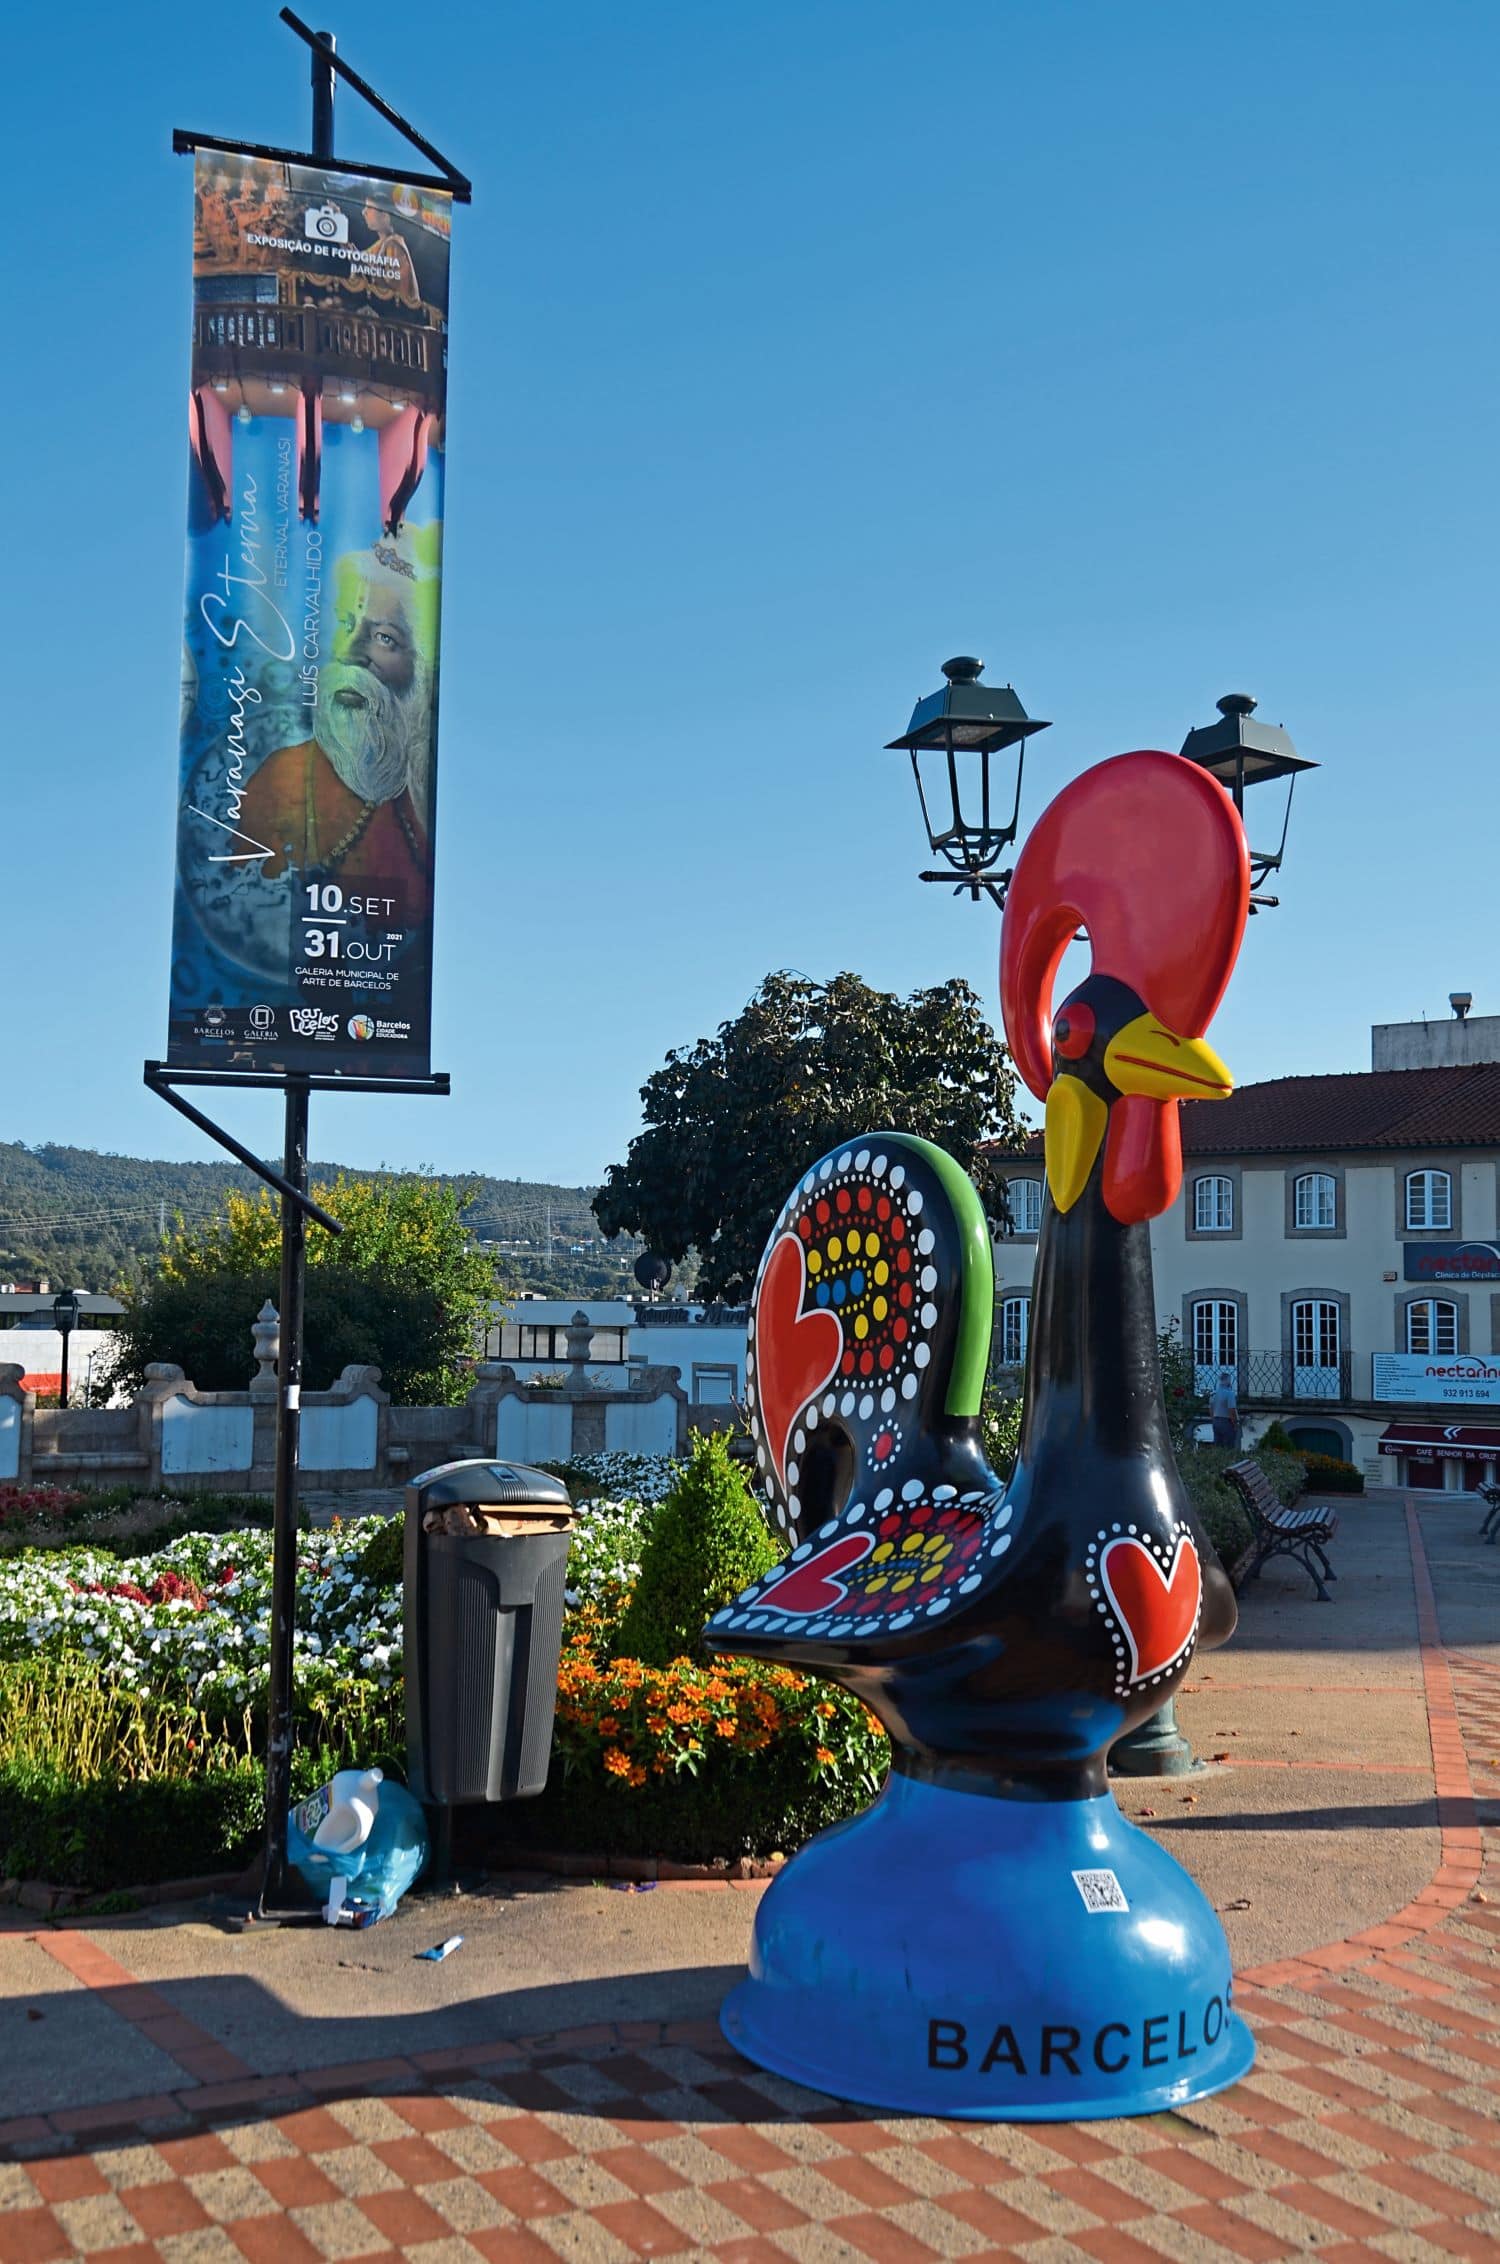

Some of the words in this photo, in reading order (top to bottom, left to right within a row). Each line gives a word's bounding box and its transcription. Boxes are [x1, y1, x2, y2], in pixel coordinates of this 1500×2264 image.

[247, 233, 312, 253] EXPOSIÇÃO
[314, 244, 329, 256] DE
[332, 247, 400, 268] FOTOGRAFIA
[350, 263, 401, 281] BARCELOS
[277, 438, 291, 513] VARANASI
[274, 518, 289, 587] ETERNAL
[200, 473, 295, 661] Eterna
[303, 531, 322, 659] CARVALHIDO
[299, 665, 319, 707] LUÍS
[188, 665, 275, 862] Varanasi
[386, 933, 403, 941] 2021
[295, 966, 334, 977] GALERIA
[335, 969, 384, 980] MUNICIPAL
[386, 972, 399, 981] DE
[302, 977, 327, 986] ARTE
[328, 978, 342, 987] DE
[343, 980, 392, 991] BARCELOS
[193, 1027, 235, 1036] BARCELOS
[376, 1020, 411, 1030] Barcelos
[243, 1029, 279, 1038] GALERIA
[1425, 1364, 1500, 1378] nectarin
[1442, 1389, 1457, 1398] 932
[1458, 1389, 1474, 1398] 913
[1437, 1449, 1463, 1458] SENHOR
[1466, 1450, 1475, 1459] DA
[1478, 1452, 1497, 1461] CRUZ
